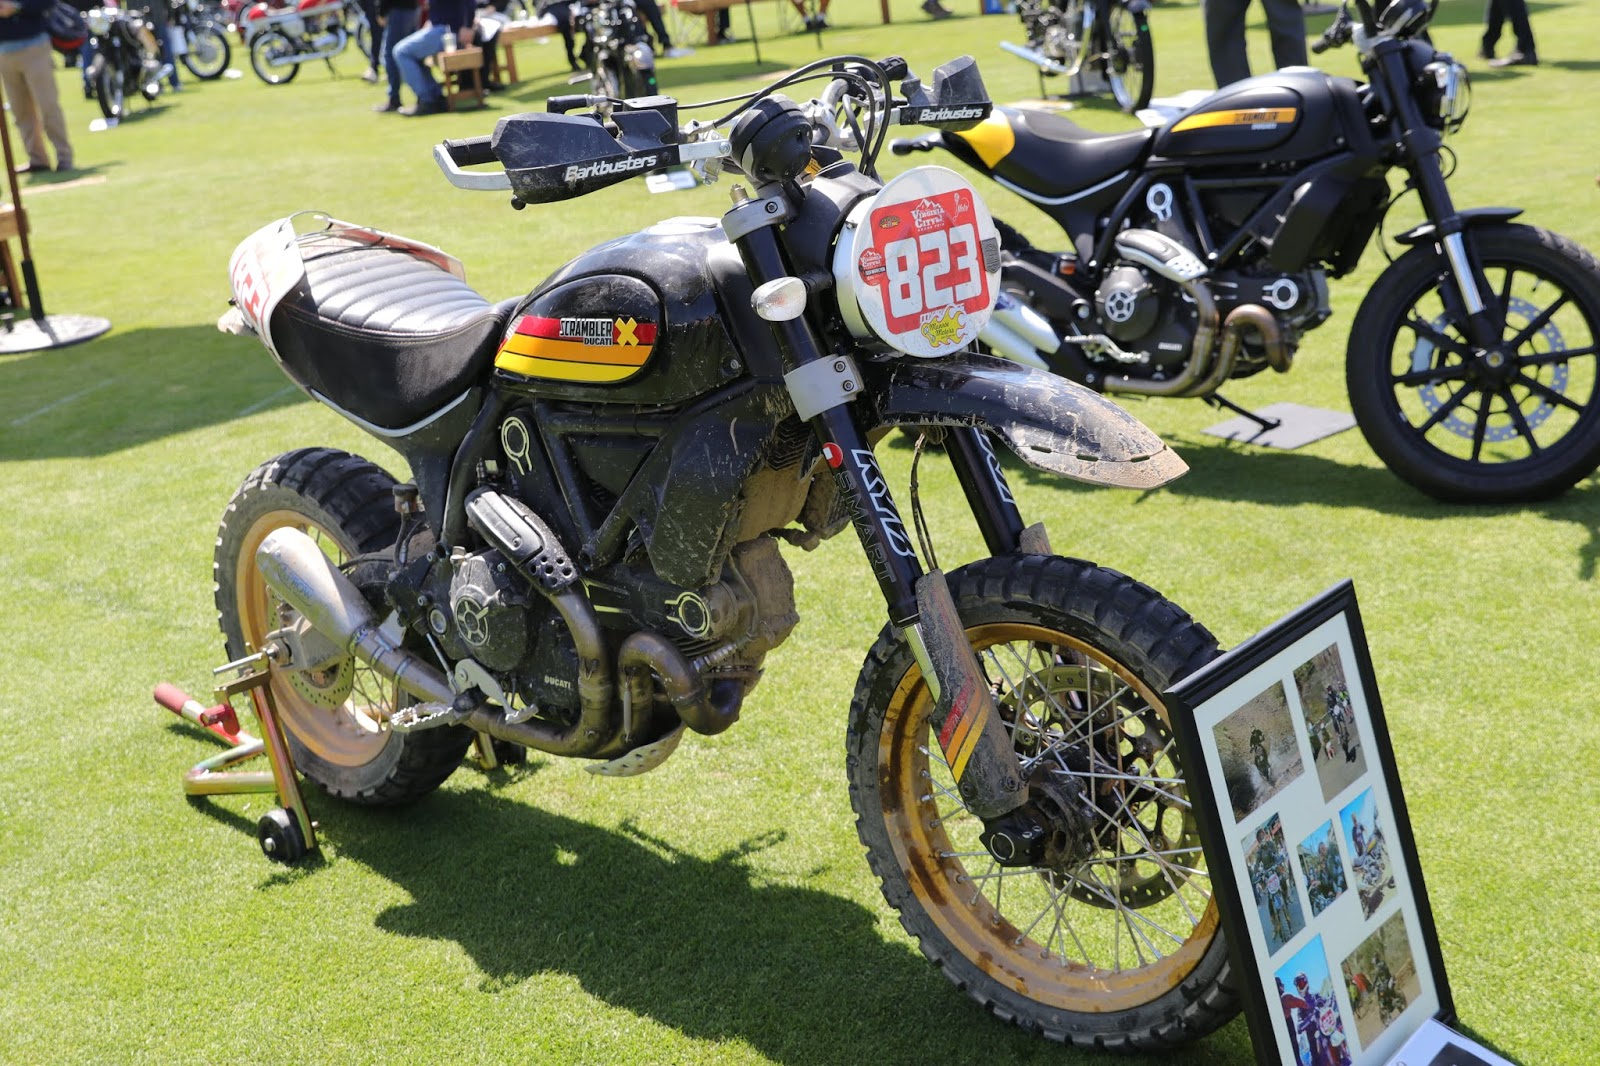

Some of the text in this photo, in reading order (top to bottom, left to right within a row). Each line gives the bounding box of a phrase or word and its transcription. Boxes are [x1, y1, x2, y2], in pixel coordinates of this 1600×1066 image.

[918, 106, 983, 121] Barkbusters
[564, 155, 657, 182] Barkbusters
[884, 223, 982, 318] 823
[559, 318, 613, 337] SCRAMBLER
[584, 337, 613, 346] DUCATI
[835, 470, 897, 583] SMART
[544, 675, 571, 689] DUCATI
